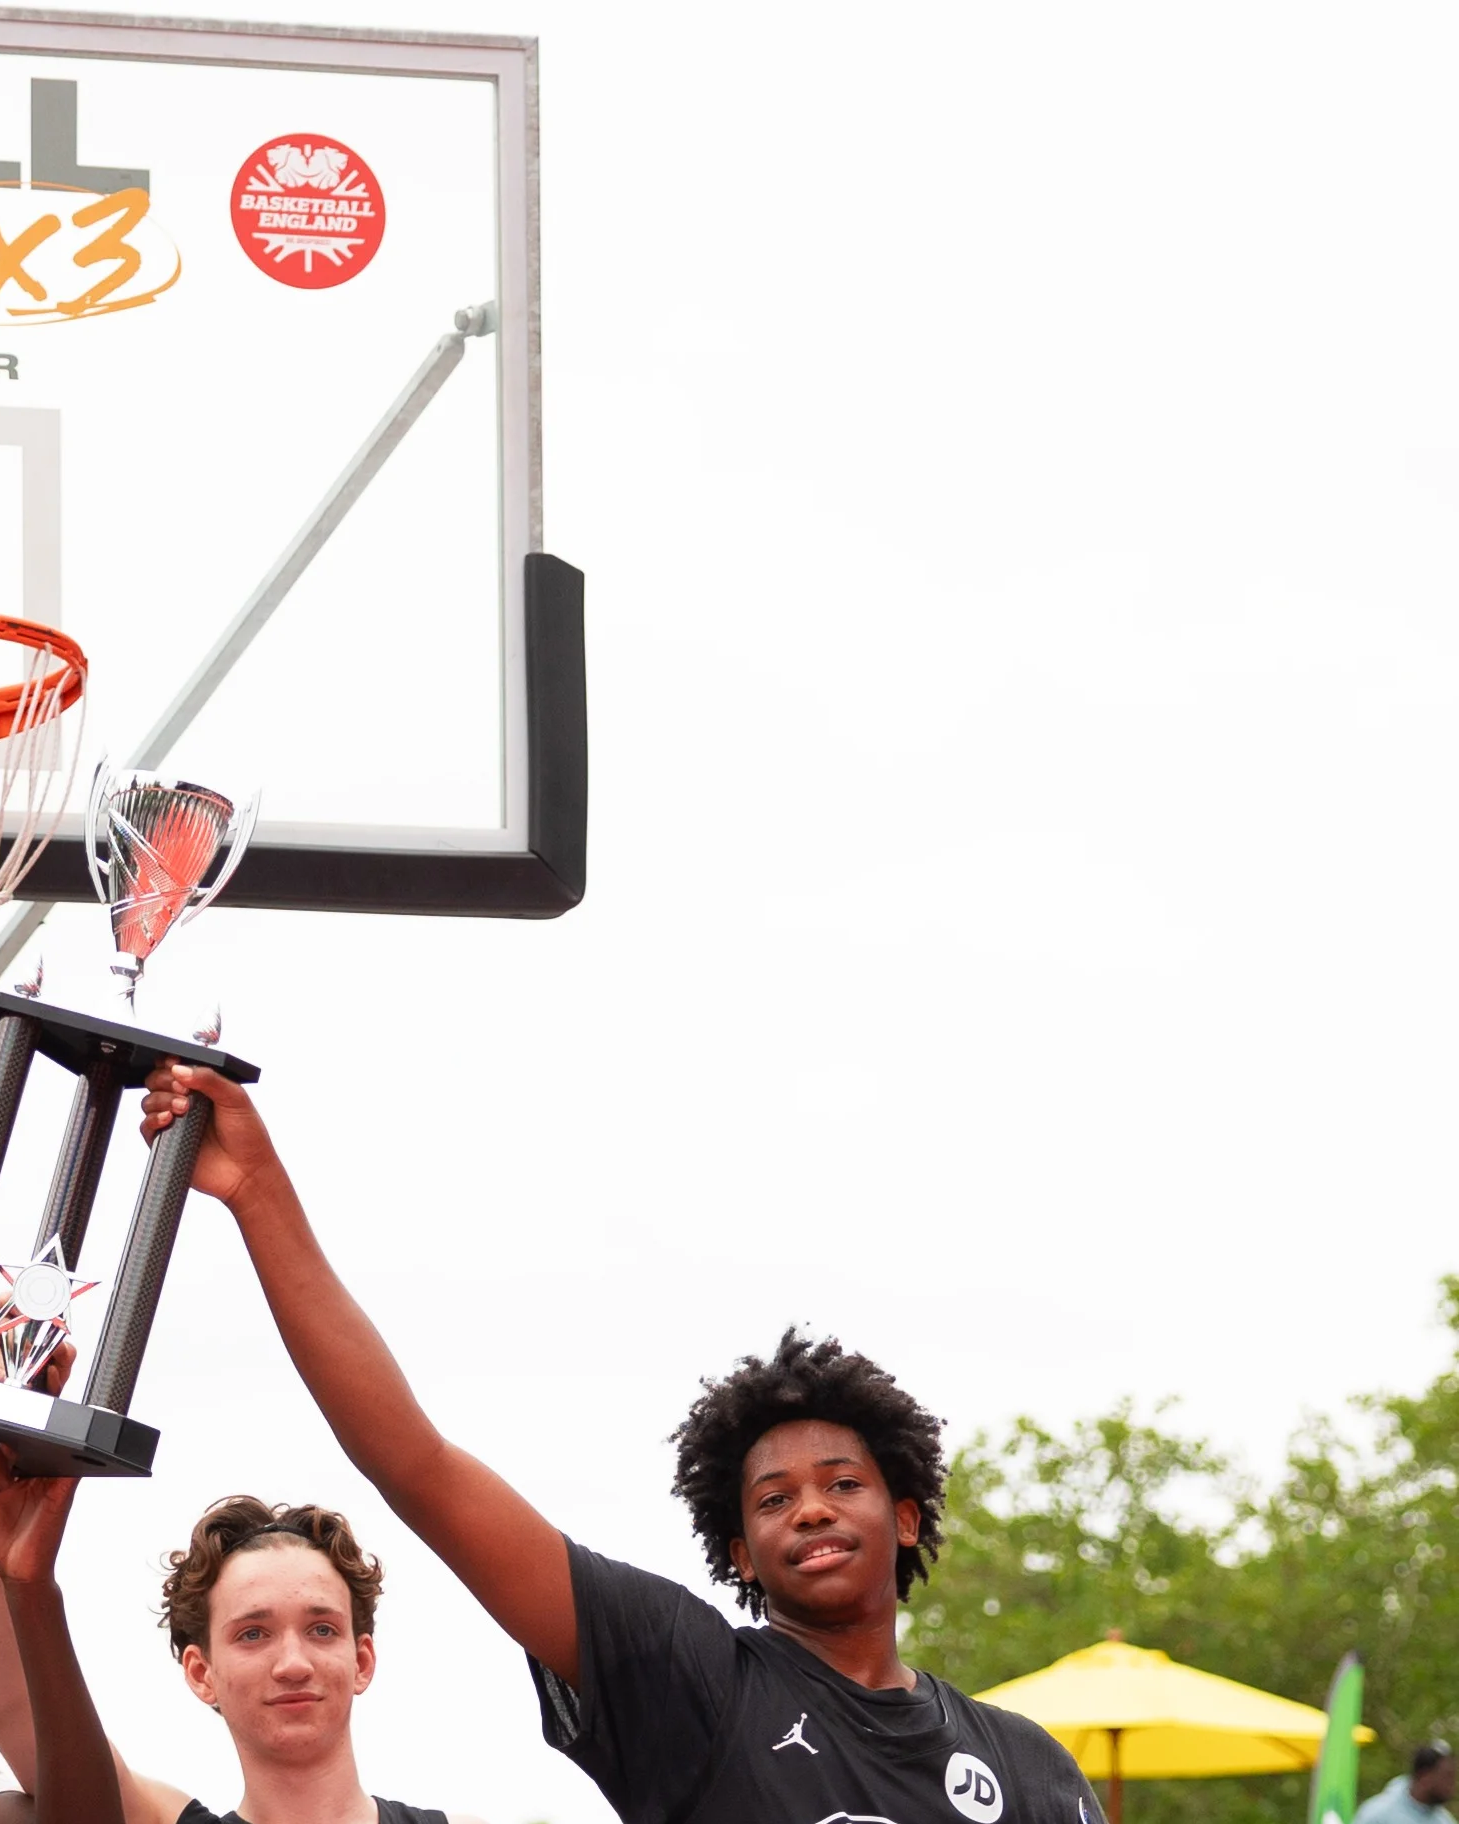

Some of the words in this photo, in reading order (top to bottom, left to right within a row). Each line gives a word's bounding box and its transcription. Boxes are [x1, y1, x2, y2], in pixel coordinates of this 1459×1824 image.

[240, 194, 376, 217] BASKETBALL
[258, 212, 358, 233] ENGLAND
[952, 1768, 996, 1806] JD
